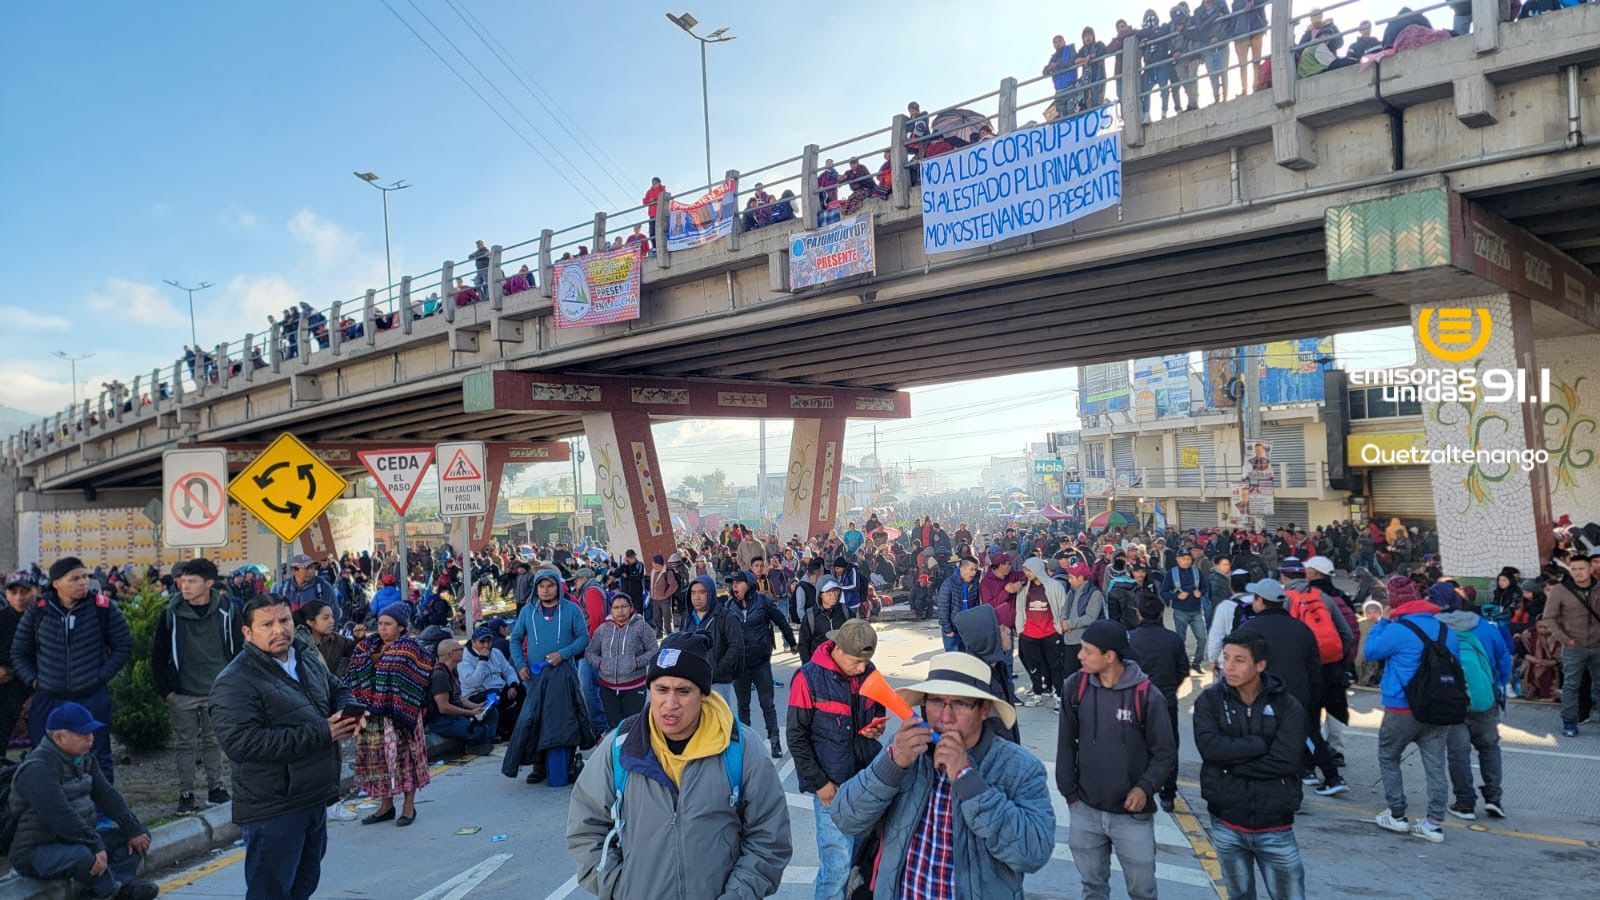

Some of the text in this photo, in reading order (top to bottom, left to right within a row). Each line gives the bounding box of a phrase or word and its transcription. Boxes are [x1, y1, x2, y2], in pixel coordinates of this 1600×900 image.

[921, 107, 1113, 185] NO A LOS CORRUPTOS
[923, 191, 937, 213] SI
[1014, 135, 1121, 195] PLURINACIONAL
[925, 170, 1120, 248] MOMOSTENANGO PRESENTE
[816, 248, 858, 270] PRESENTE
[596, 283, 631, 297] PRESENTE
[377, 456, 419, 471] CEDA
[1037, 461, 1062, 472] Hola
[394, 474, 404, 482] EL
[388, 484, 410, 492] PASO
[443, 484, 481, 494] PRECAUCIÓN
[445, 503, 481, 512] PEATONAL
